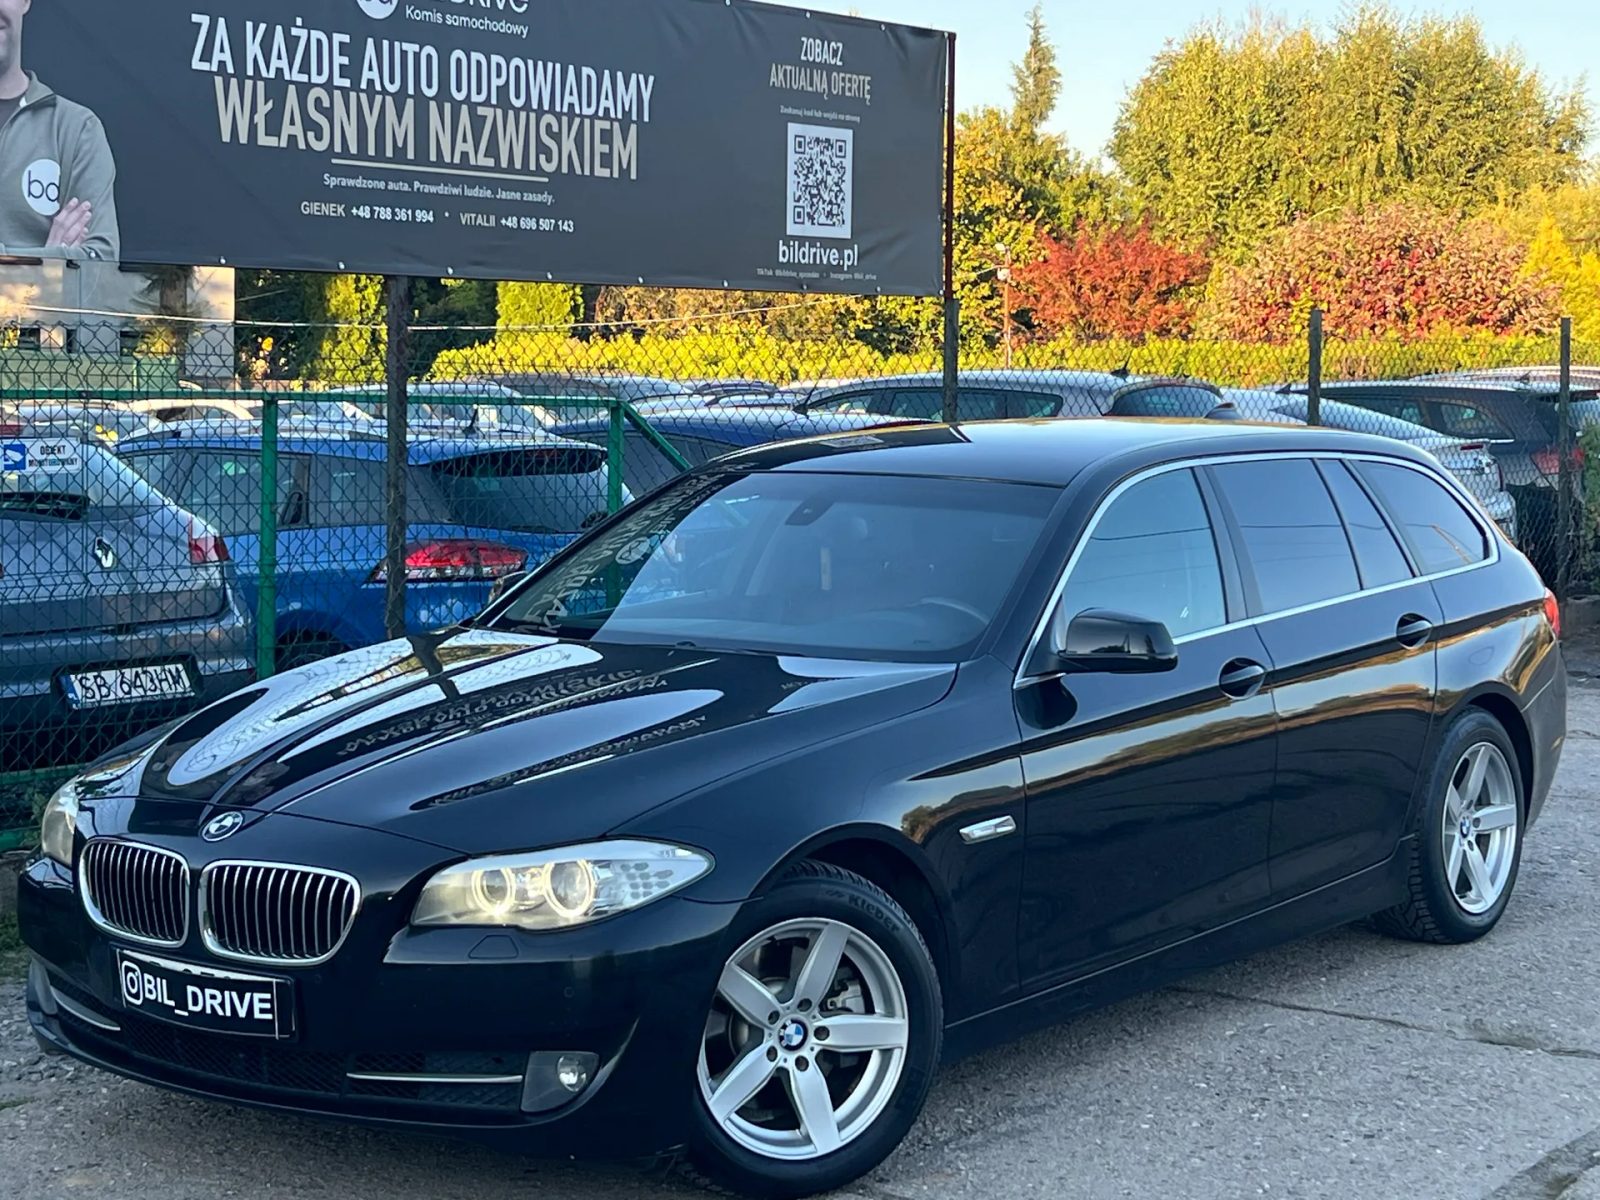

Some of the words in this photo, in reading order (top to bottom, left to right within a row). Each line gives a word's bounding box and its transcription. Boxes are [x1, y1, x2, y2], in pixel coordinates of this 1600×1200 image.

[405, 5, 443, 24] Komis
[445, 13, 528, 39] samochodowy
[191, 13, 235, 74] ZA
[245, 17, 350, 88] KAŻDE
[360, 37, 439, 98] AUTO
[450, 49, 655, 122] ODPOWIADAMY
[800, 36, 843, 66] ZOBACZ
[769, 63, 828, 100] AKTUALNĄ
[831, 72, 872, 106] OFERTĘ
[214, 75, 415, 160] WŁASNYM
[429, 100, 638, 180] NAZWISKIEM
[323, 173, 386, 190] Sprawdzone
[387, 181, 412, 192] auta.
[413, 181, 463, 196] Prawdziwi
[464, 184, 495, 198] ludzie.
[496, 187, 521, 201] Jasne
[522, 190, 555, 206] zasady.
[300, 201, 346, 217] GIENEK
[351, 206, 371, 219] +48
[373, 207, 392, 220] 788
[394, 208, 413, 222] 361
[415, 209, 434, 223] 994
[459, 213, 496, 227] VITALII
[500, 215, 518, 229] +48
[520, 216, 537, 230] 696
[538, 217, 555, 231] 507
[558, 219, 574, 233] 143
[779, 239, 859, 271] bildrive.pl
[143, 973, 273, 1020] BIL_DRIVE
